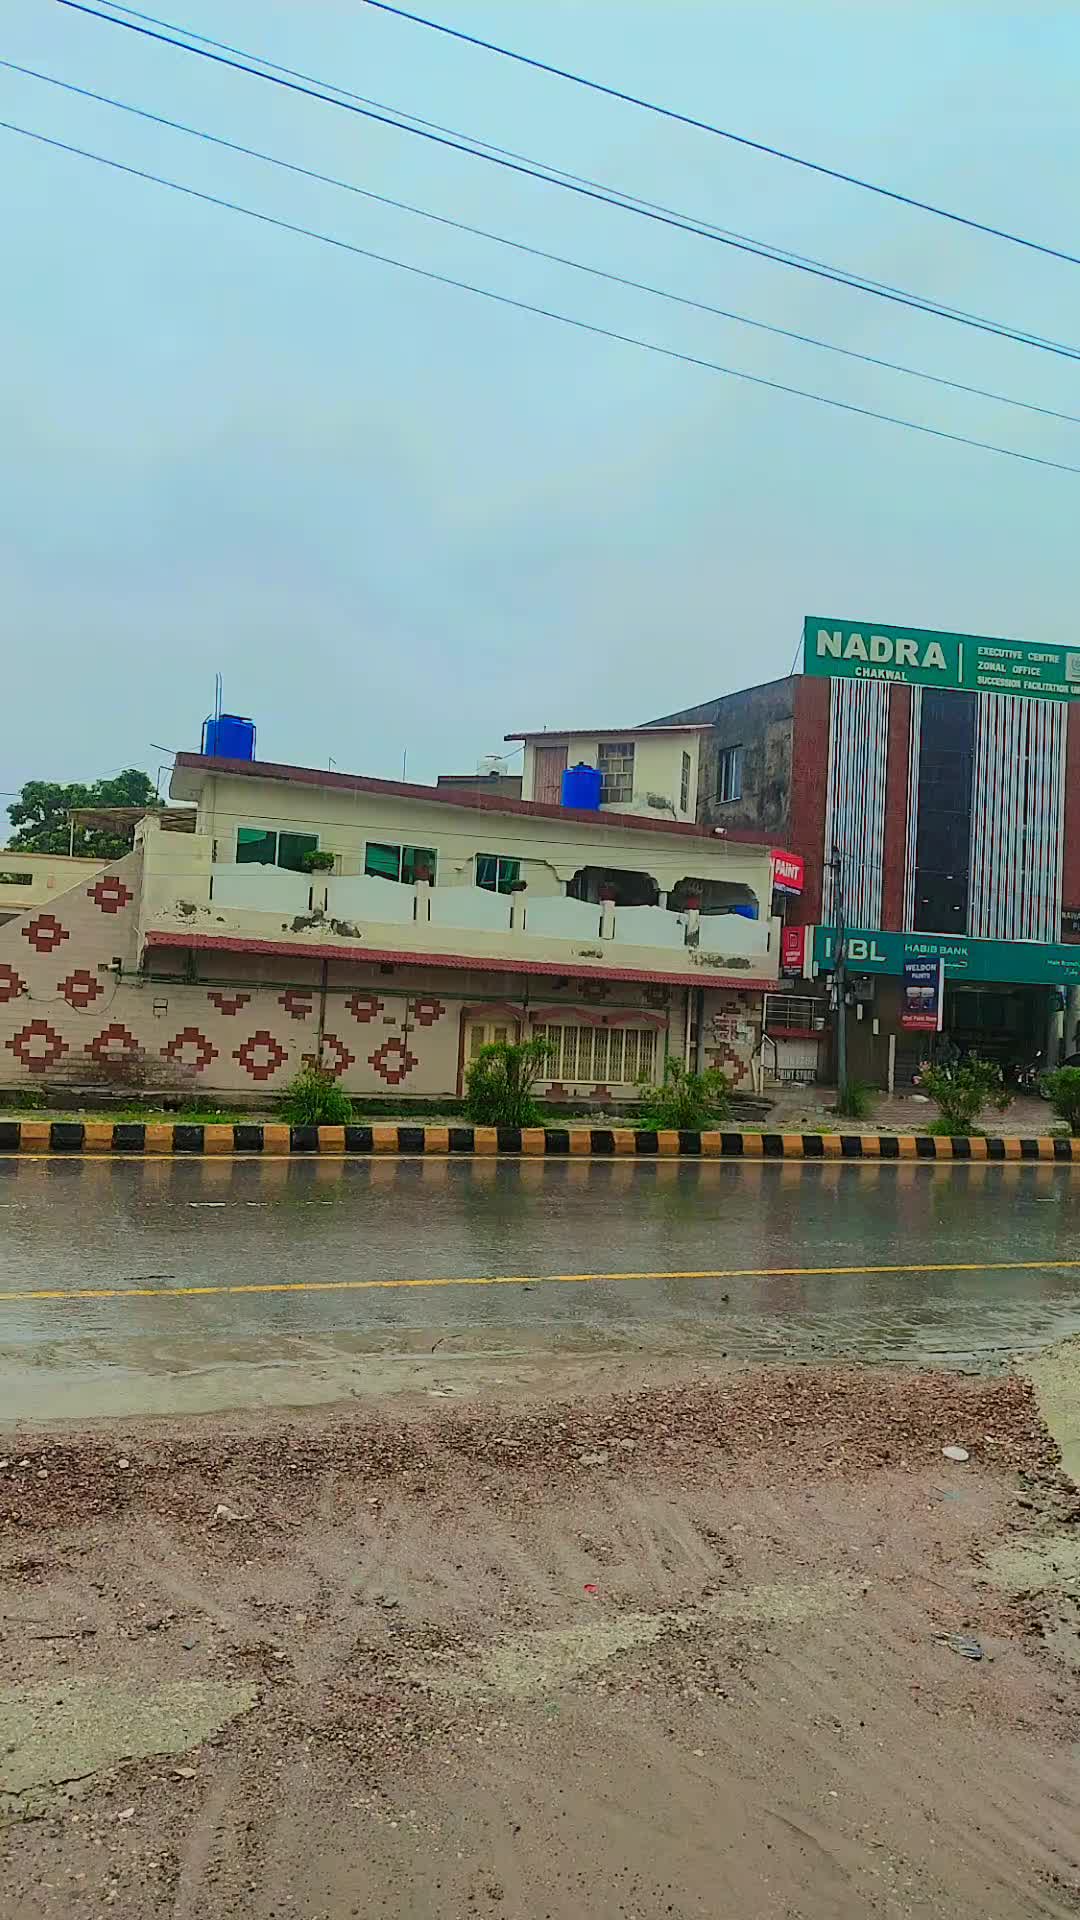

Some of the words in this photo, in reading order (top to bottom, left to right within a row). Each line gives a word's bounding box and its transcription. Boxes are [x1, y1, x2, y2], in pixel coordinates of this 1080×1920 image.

[816, 629, 947, 669] NADRA
[977, 646, 1023, 660] EXECUTIVE
[1027, 652, 1060, 664] CENTRE
[854, 666, 908, 681] CHAKWAL
[976, 660, 1007, 673] ZONAL
[1012, 665, 1042, 677] OFFICE
[976, 675, 1021, 689] SUCCESSION
[775, 858, 800, 880] PAINT
[904, 943, 938, 953] HABIB
[939, 946, 969, 956] BANK
[905, 963, 937, 972] WELDON
